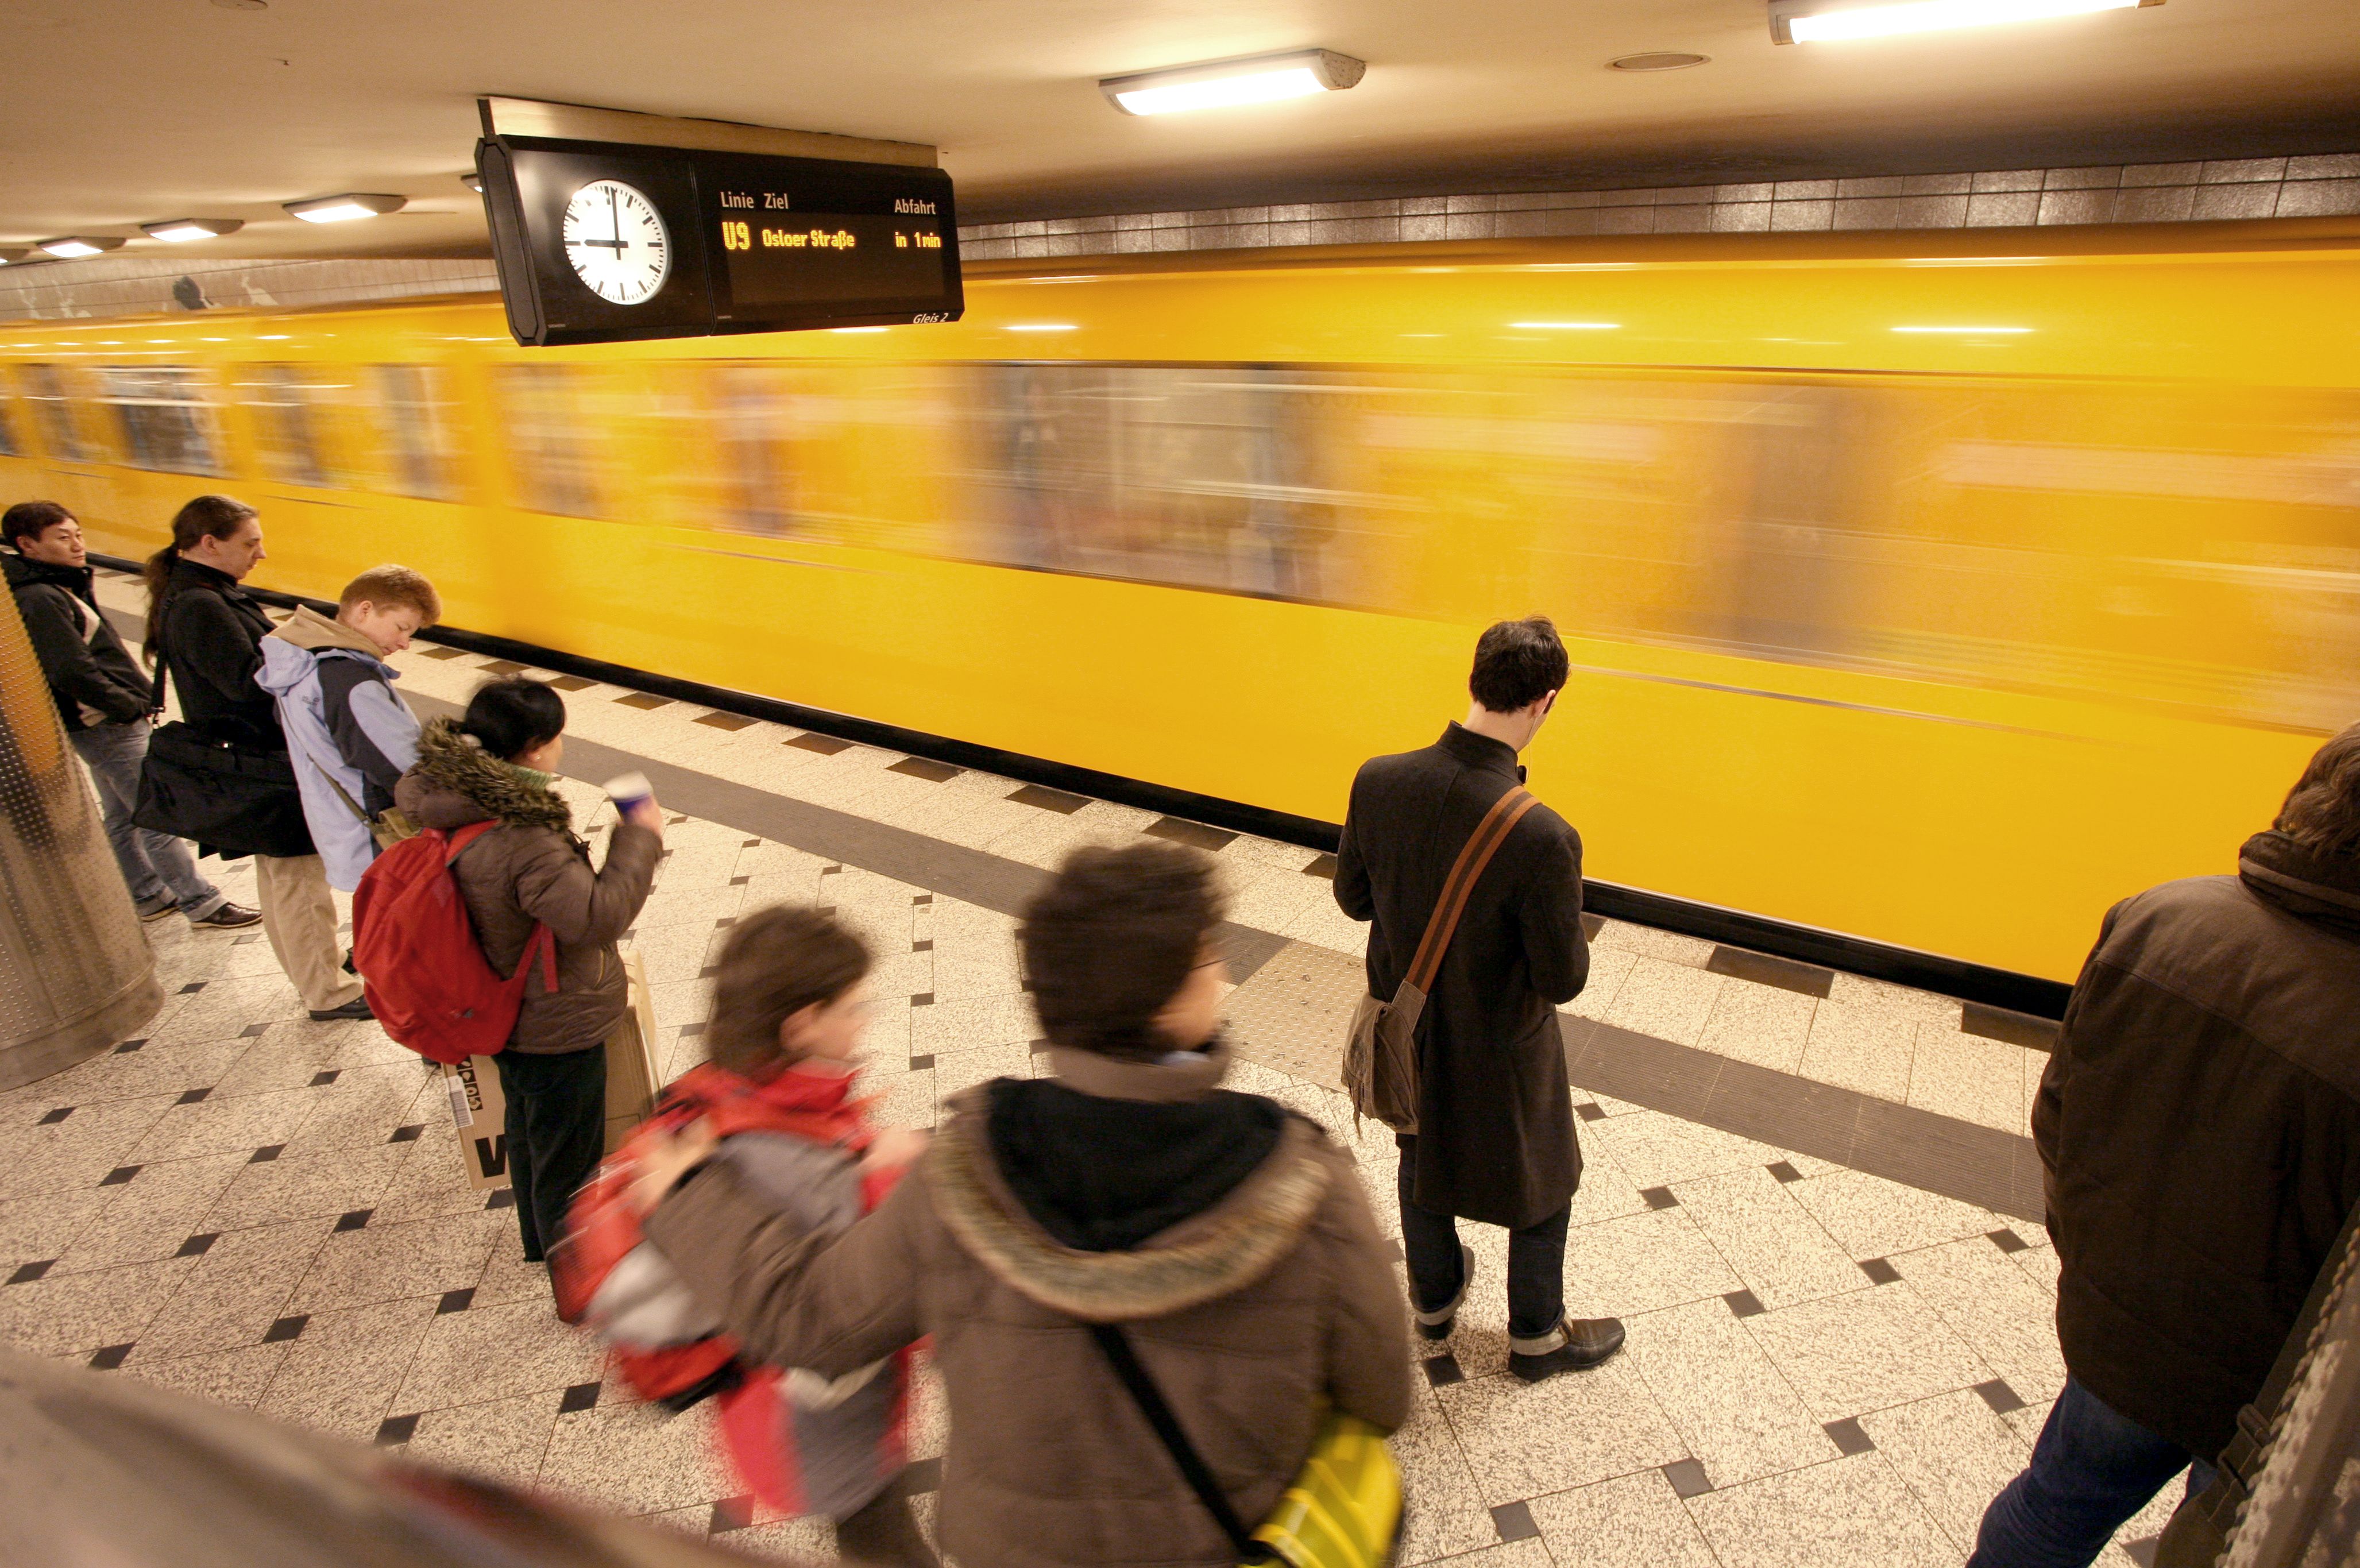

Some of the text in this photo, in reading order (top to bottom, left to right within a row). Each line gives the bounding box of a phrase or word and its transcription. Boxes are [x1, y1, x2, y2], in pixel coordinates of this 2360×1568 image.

[720, 191, 936, 215] Linie Ziel Abfahrt
[721, 222, 750, 250] U9
[762, 229, 808, 247] Osloer
[810, 230, 856, 250] Straße
[895, 231, 907, 248] in
[913, 312, 949, 324] Gleis 2
